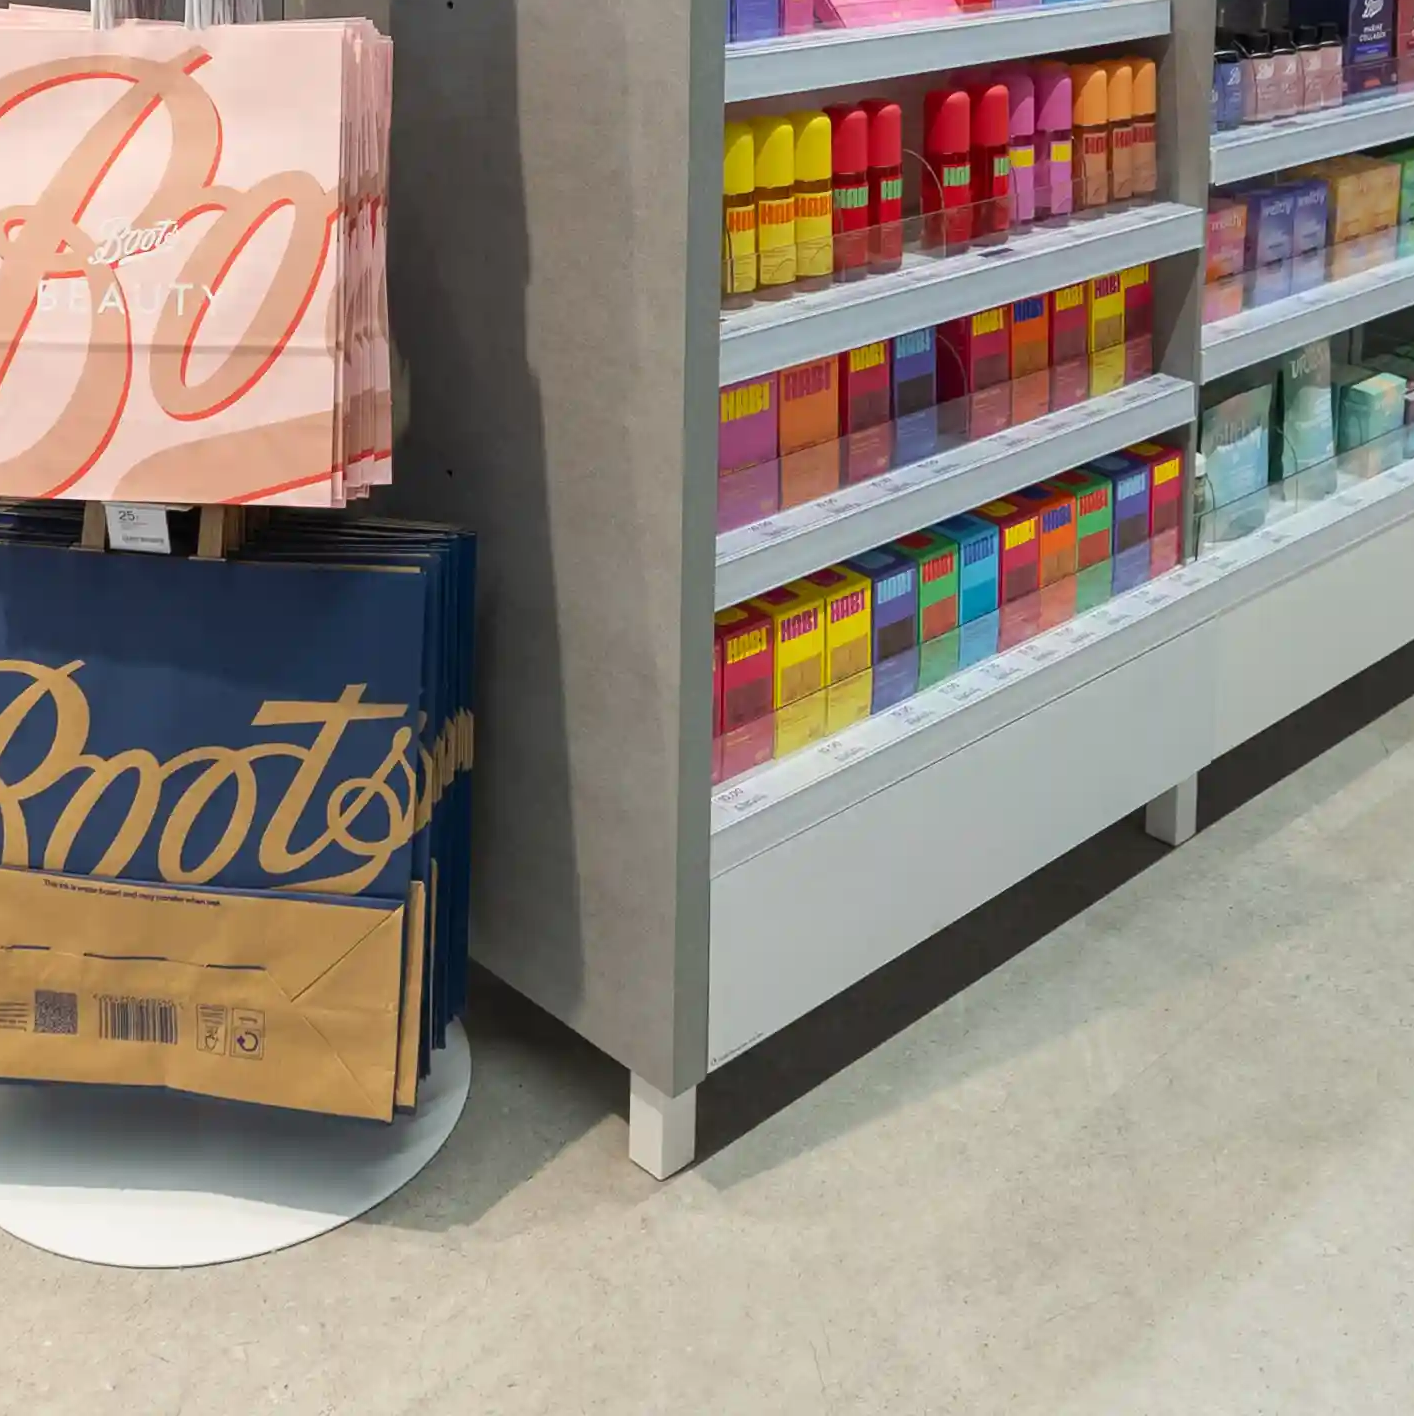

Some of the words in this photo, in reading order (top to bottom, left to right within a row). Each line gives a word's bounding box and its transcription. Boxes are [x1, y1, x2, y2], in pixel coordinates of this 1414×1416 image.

[87, 216, 180, 267] Boots
[39, 283, 224, 317] BEAUTY
[720, 381, 771, 423] HABI
[830, 587, 866, 624] HABI
[780, 607, 819, 643] HABI
